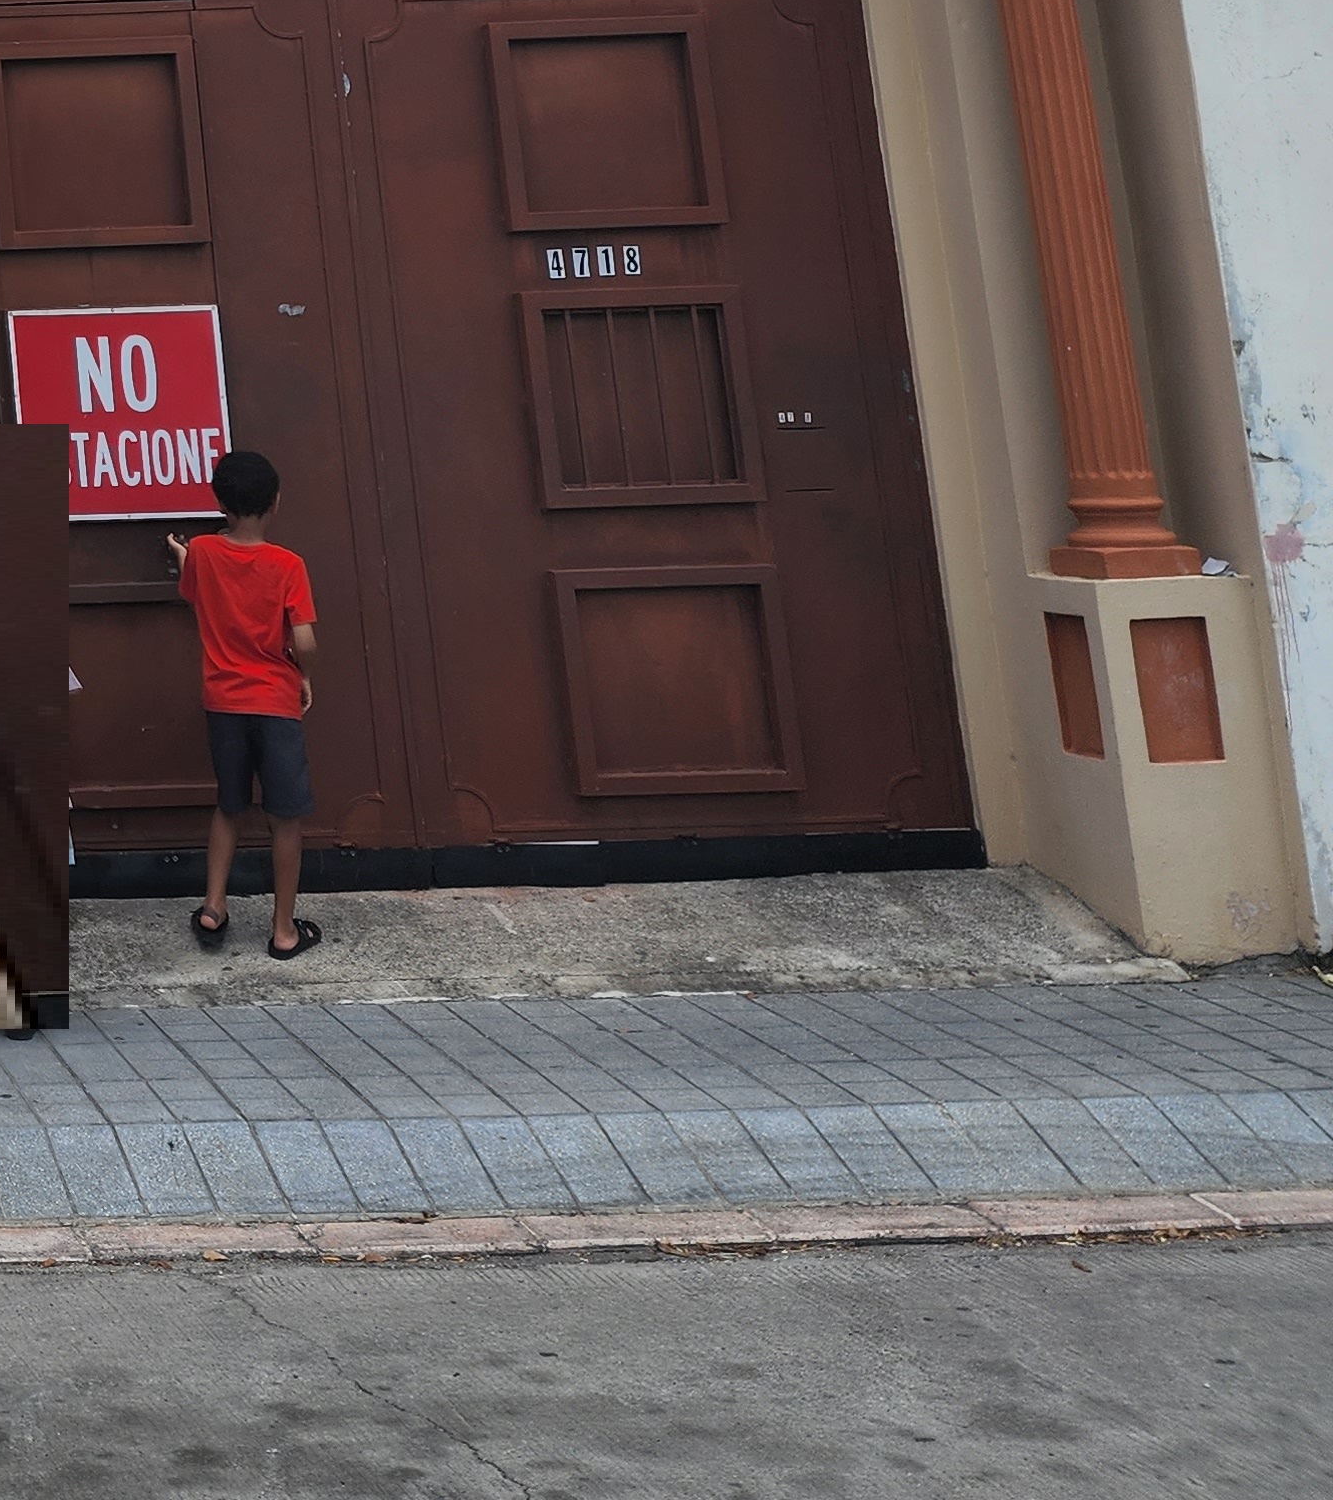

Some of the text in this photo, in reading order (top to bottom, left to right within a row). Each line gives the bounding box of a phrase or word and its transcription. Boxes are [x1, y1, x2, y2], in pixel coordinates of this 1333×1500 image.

[550, 246, 639, 277] 4718
[74, 334, 158, 413] NO
[69, 428, 220, 488] TACIONE
